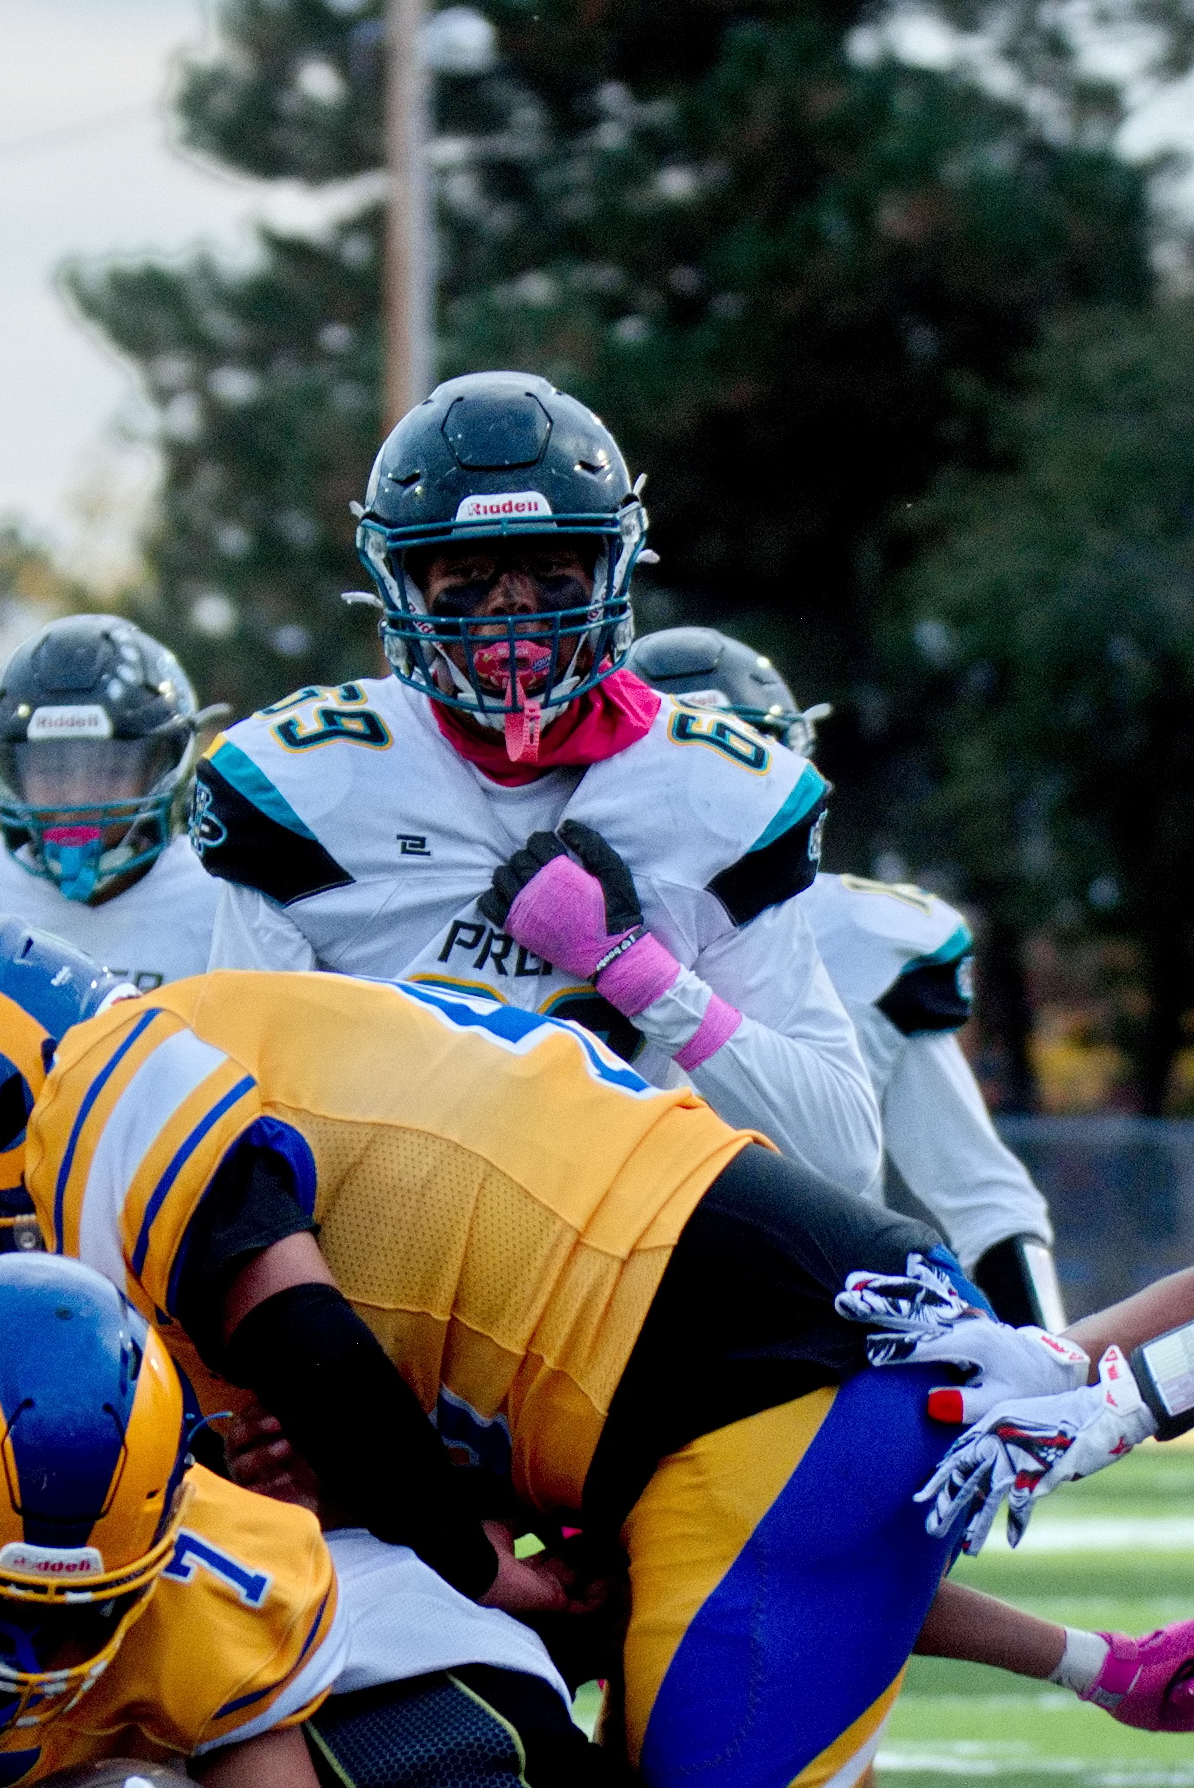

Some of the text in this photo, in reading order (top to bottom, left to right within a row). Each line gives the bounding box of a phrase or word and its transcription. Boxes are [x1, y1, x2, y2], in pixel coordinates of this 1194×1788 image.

[467, 499, 539, 516] Riddell
[436, 918, 554, 978] PRE
[160, 1526, 275, 1610] 7
